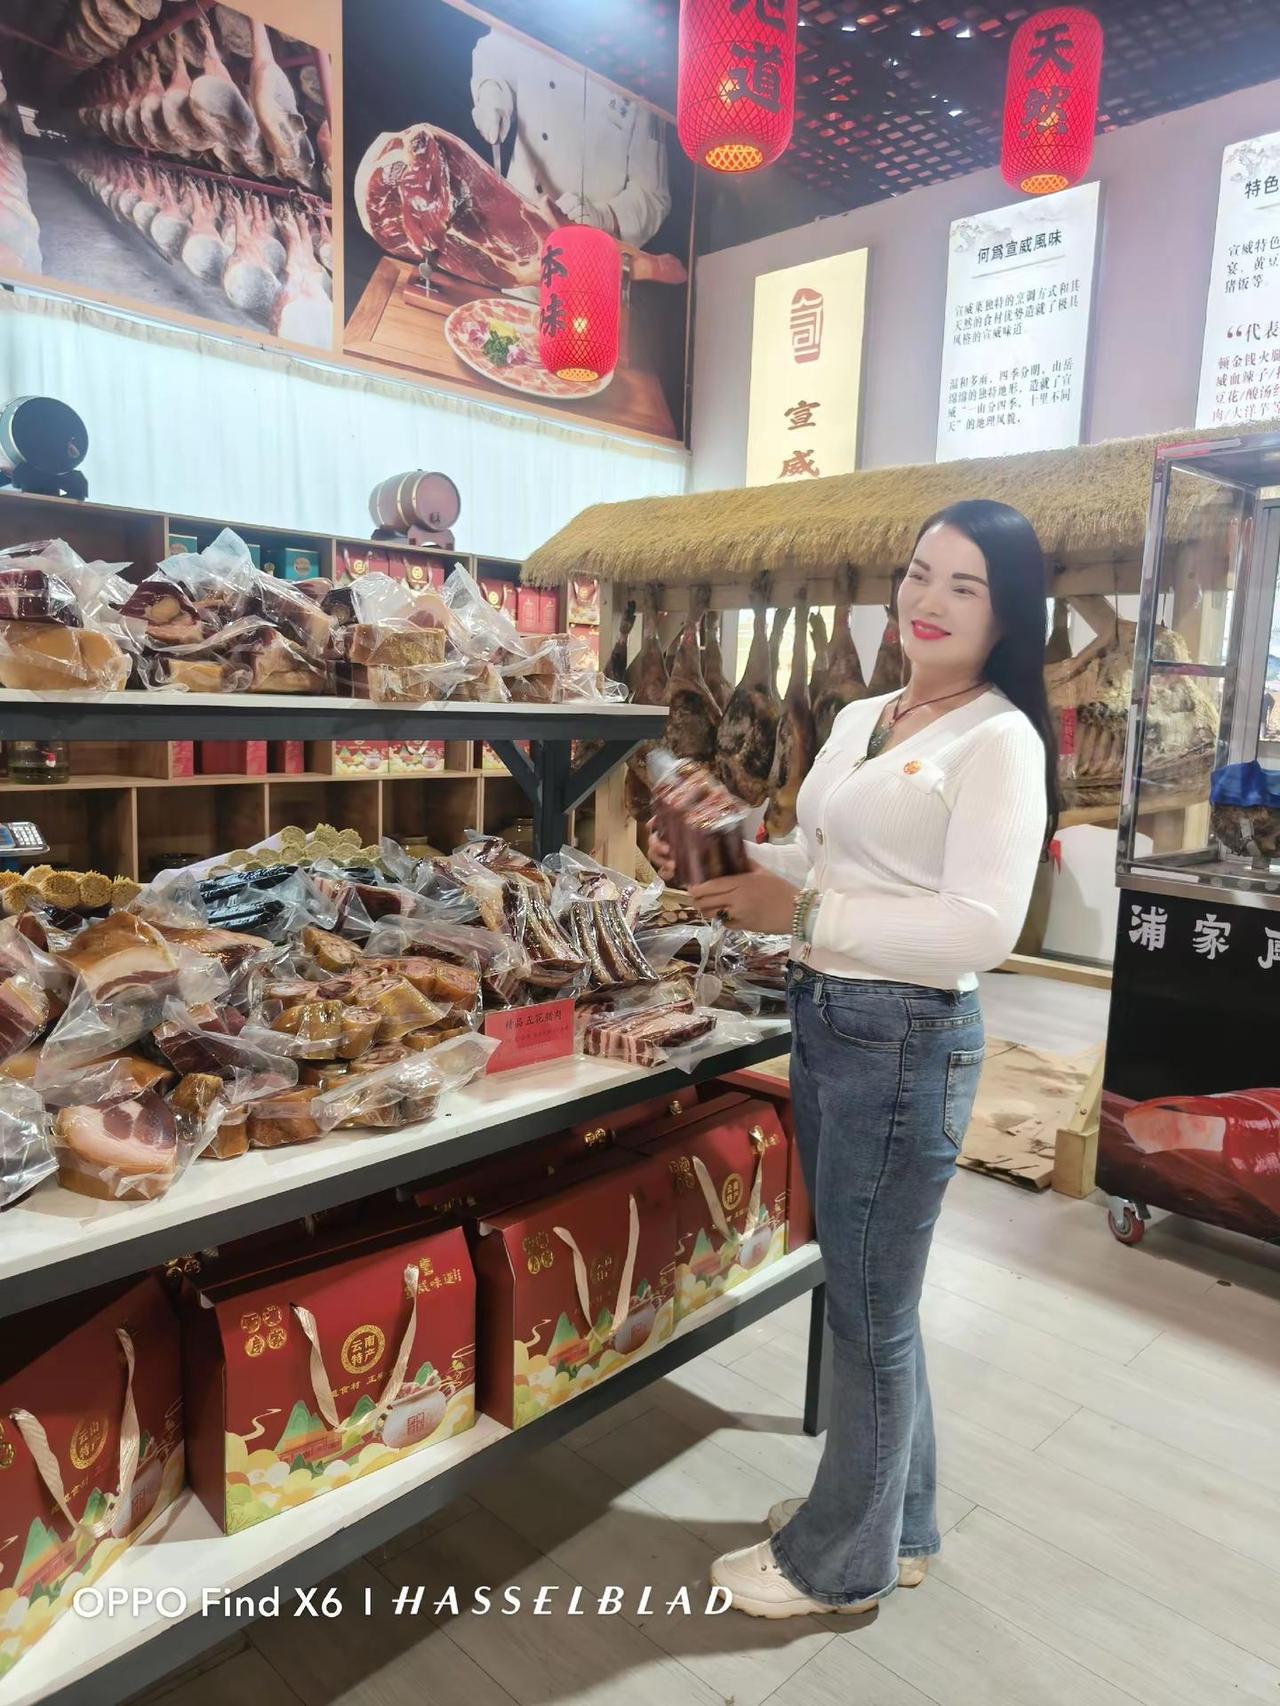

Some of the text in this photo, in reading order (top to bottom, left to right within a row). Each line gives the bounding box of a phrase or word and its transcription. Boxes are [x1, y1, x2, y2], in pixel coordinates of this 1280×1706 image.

[1018, 23, 1074, 140] 天然
[540, 244, 568, 338] 本味
[777, 400, 822, 479] 宣威
